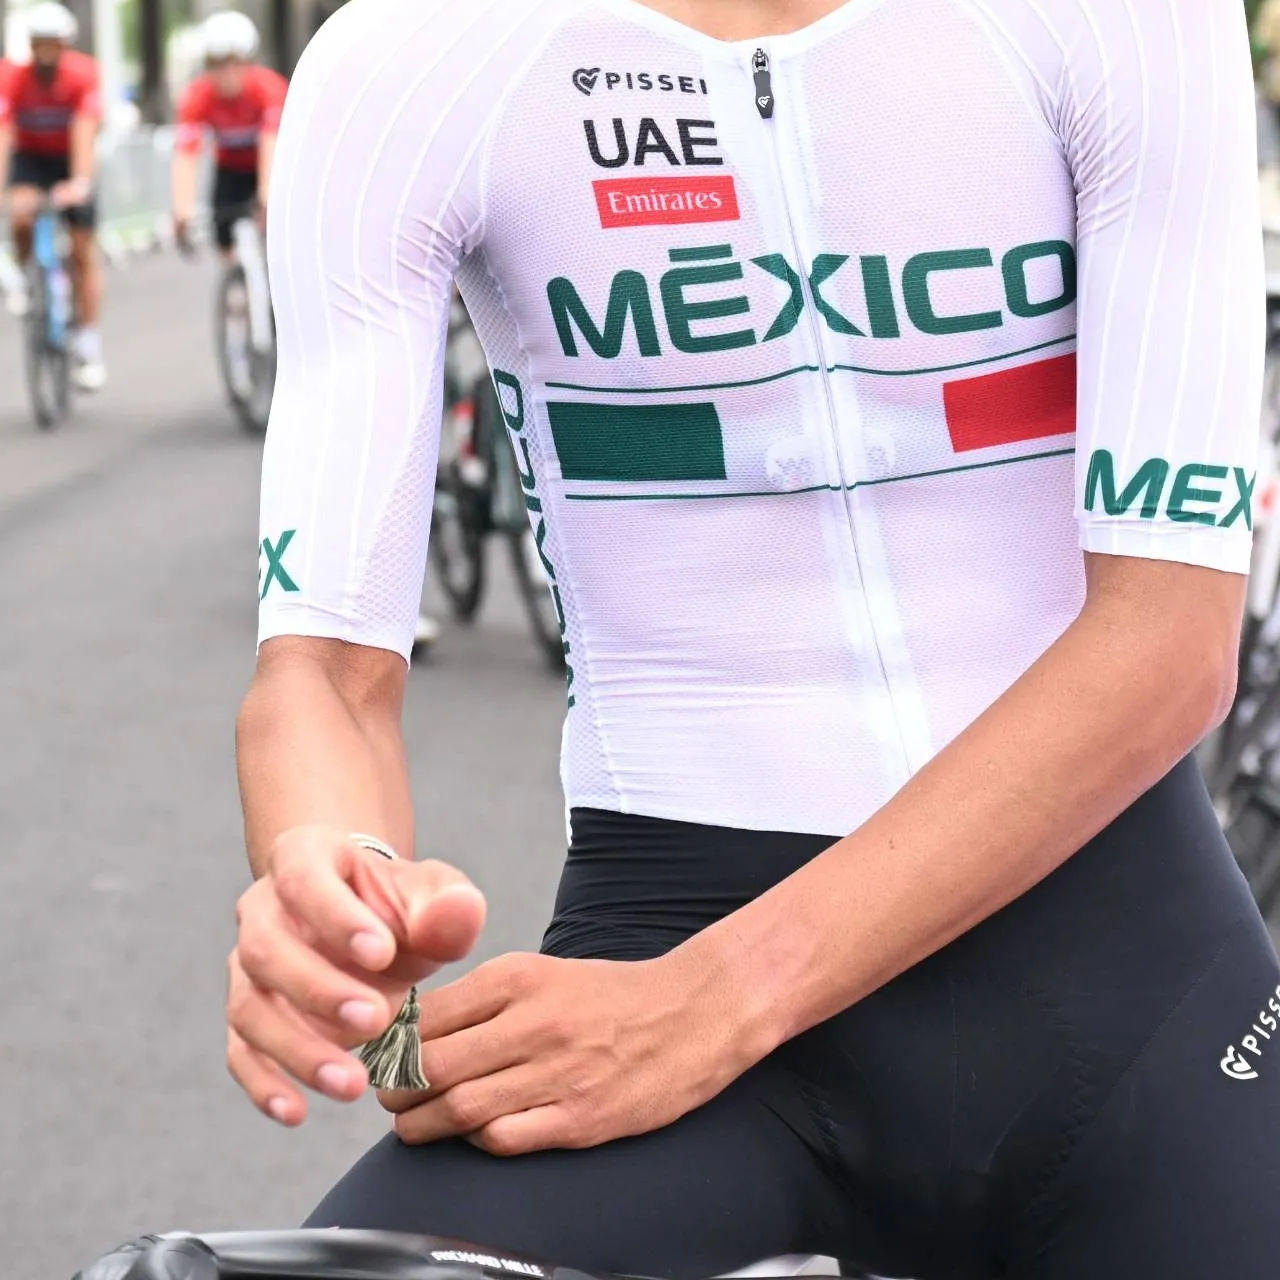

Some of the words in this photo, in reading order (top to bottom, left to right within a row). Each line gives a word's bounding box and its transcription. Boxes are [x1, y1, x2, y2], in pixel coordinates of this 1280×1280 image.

[606, 72, 708, 95] PISSEI
[583, 117, 724, 168] UAE
[608, 189, 722, 214] Emirates
[1084, 449, 1256, 531] MEX
